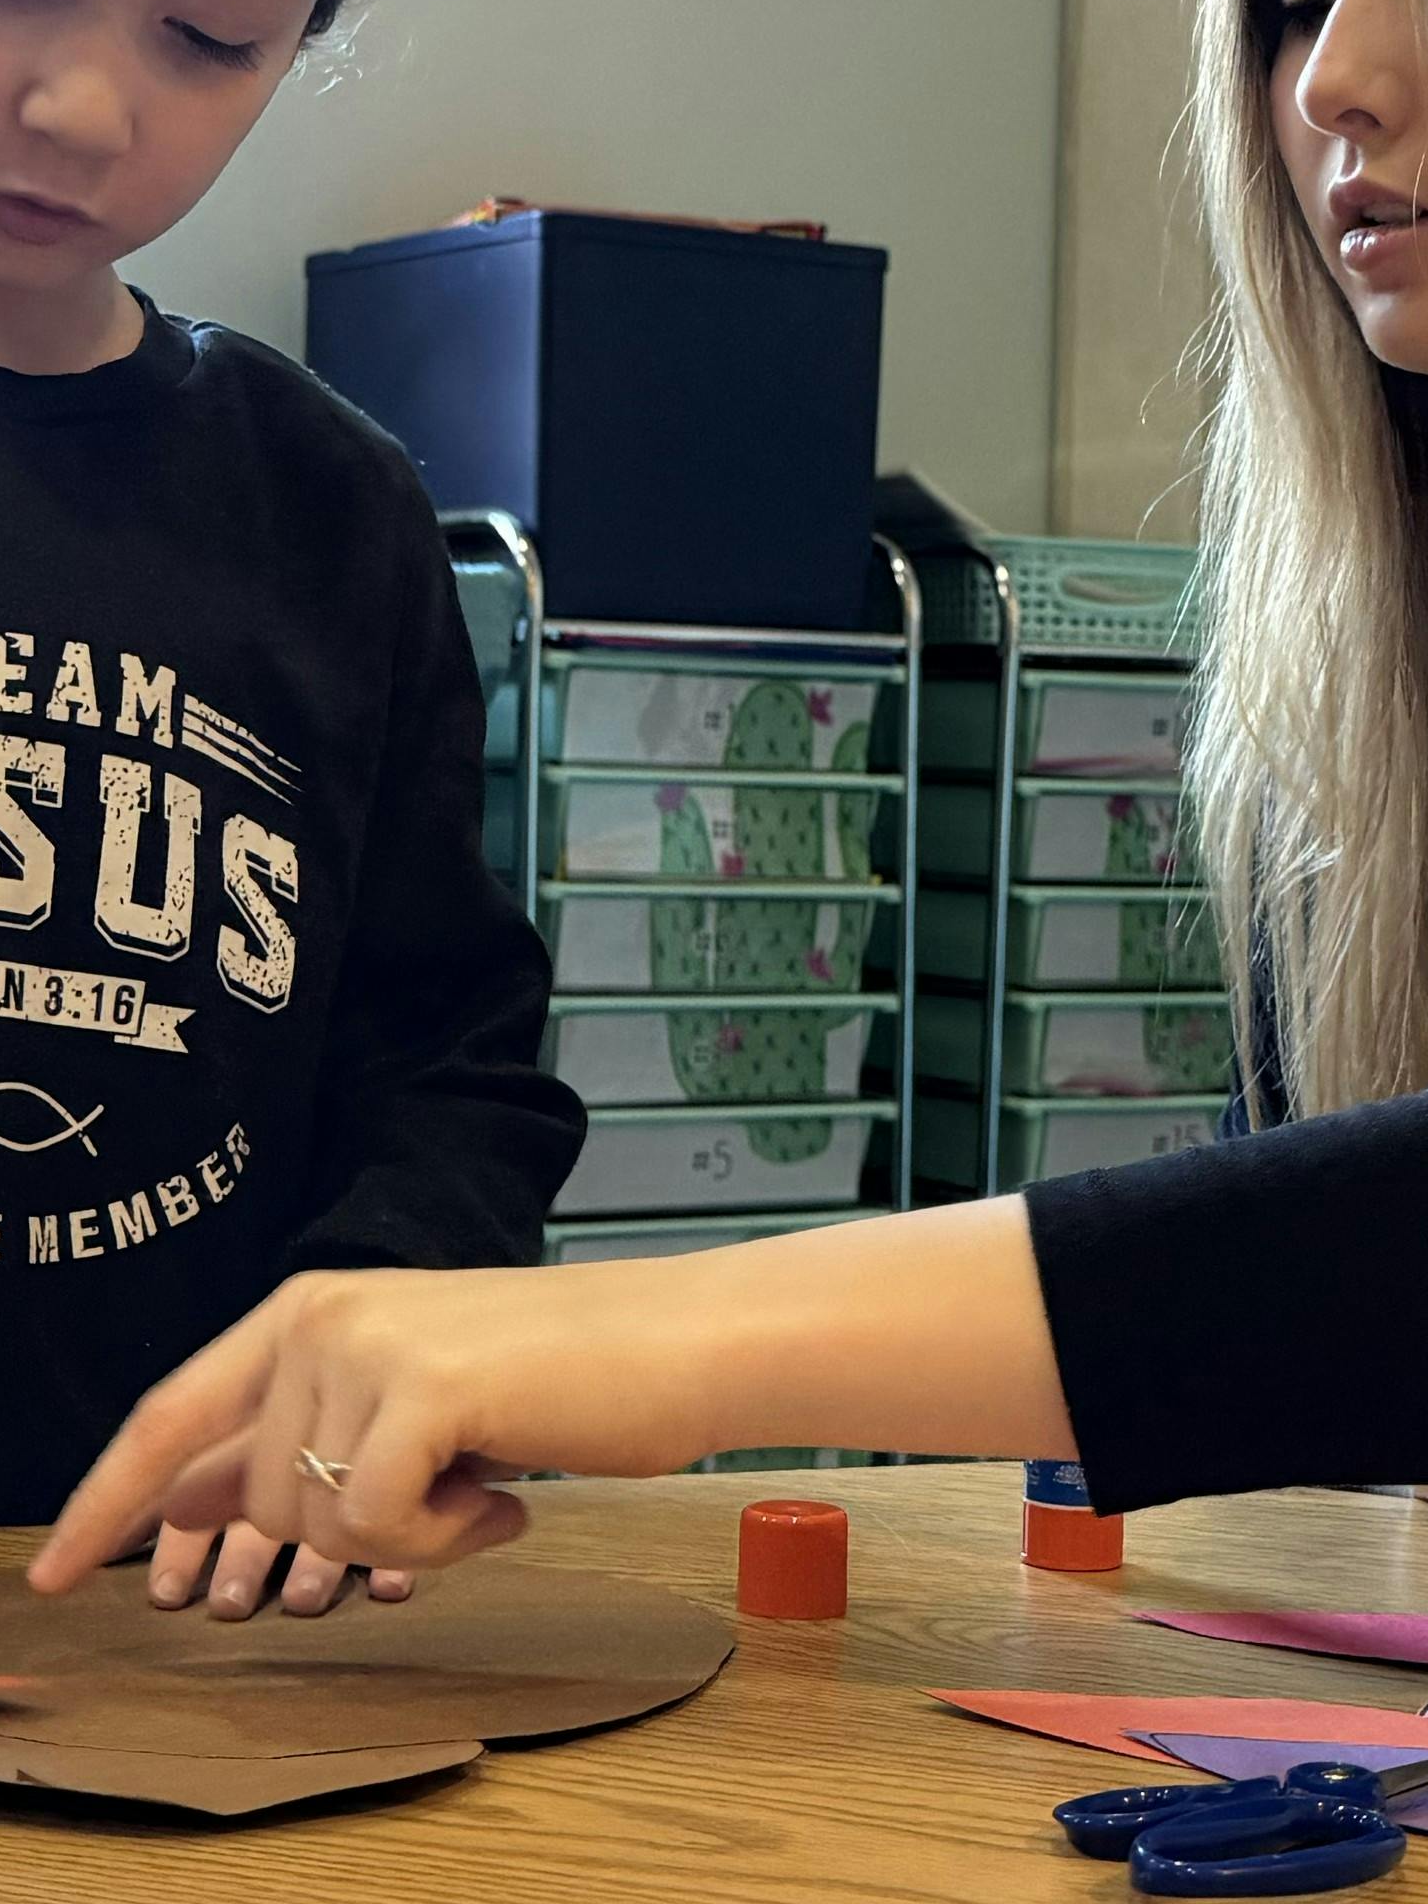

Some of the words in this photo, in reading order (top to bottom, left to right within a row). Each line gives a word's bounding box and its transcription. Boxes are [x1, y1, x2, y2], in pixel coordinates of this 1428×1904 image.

[43, 974, 138, 1027] 3:16
[691, 1140, 735, 1182] #5
[28, 1122, 253, 1265] MEMBER
